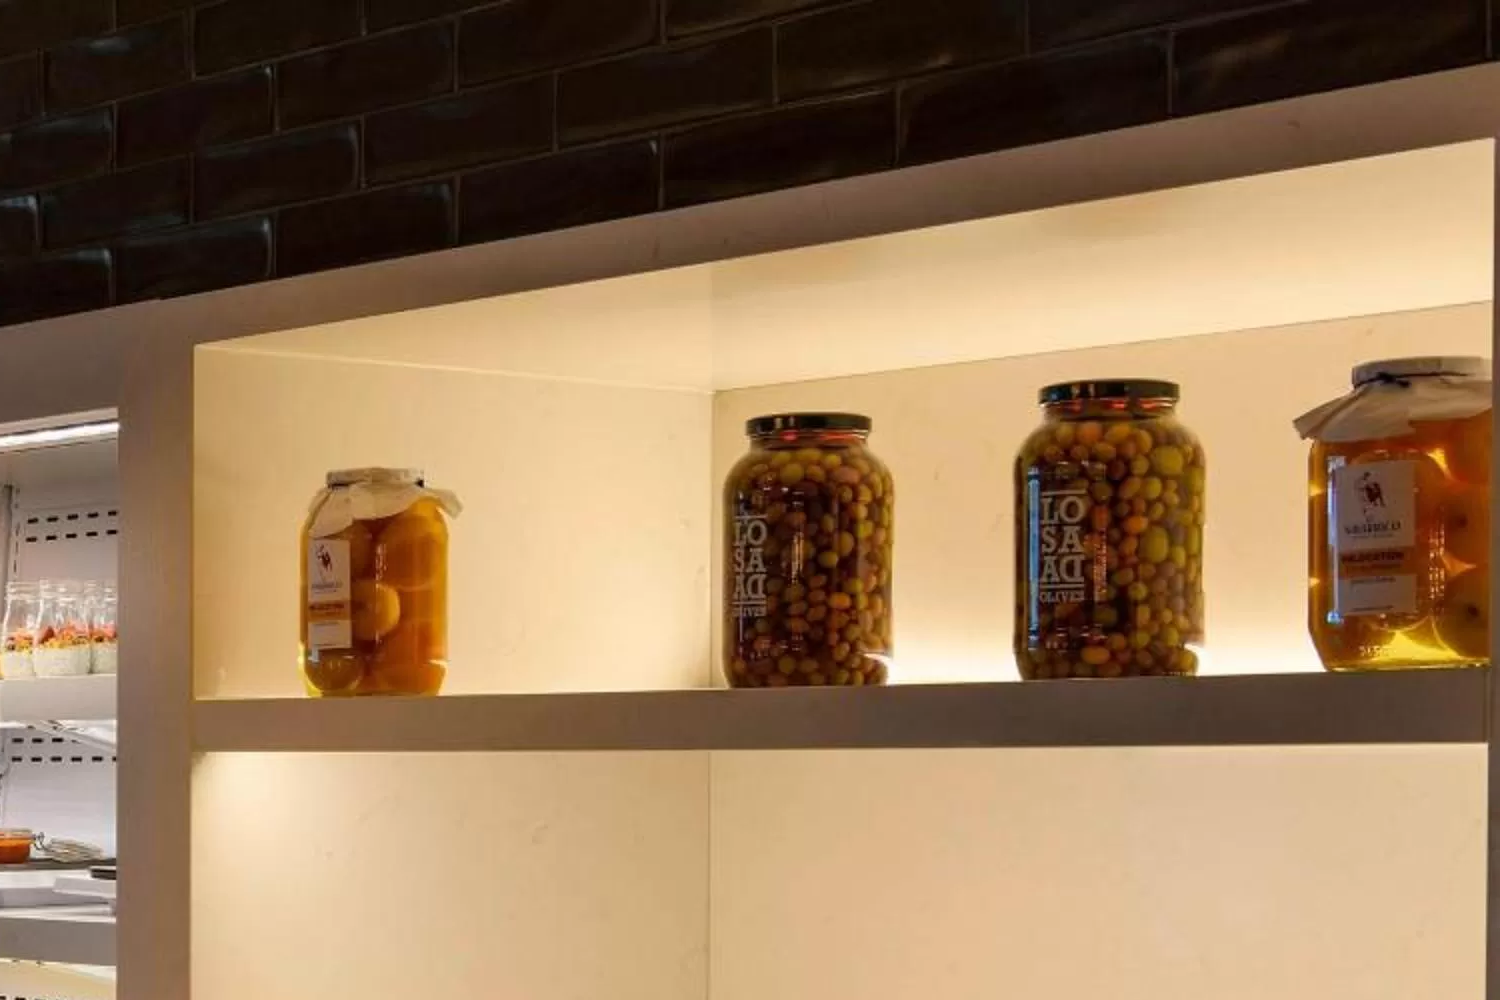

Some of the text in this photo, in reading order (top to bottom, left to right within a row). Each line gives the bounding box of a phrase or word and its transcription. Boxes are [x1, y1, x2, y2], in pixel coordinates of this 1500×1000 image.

[1041, 496, 1086, 524] LO
[733, 519, 768, 546] LO
[1041, 526, 1084, 553] SA
[733, 548, 768, 572] SA
